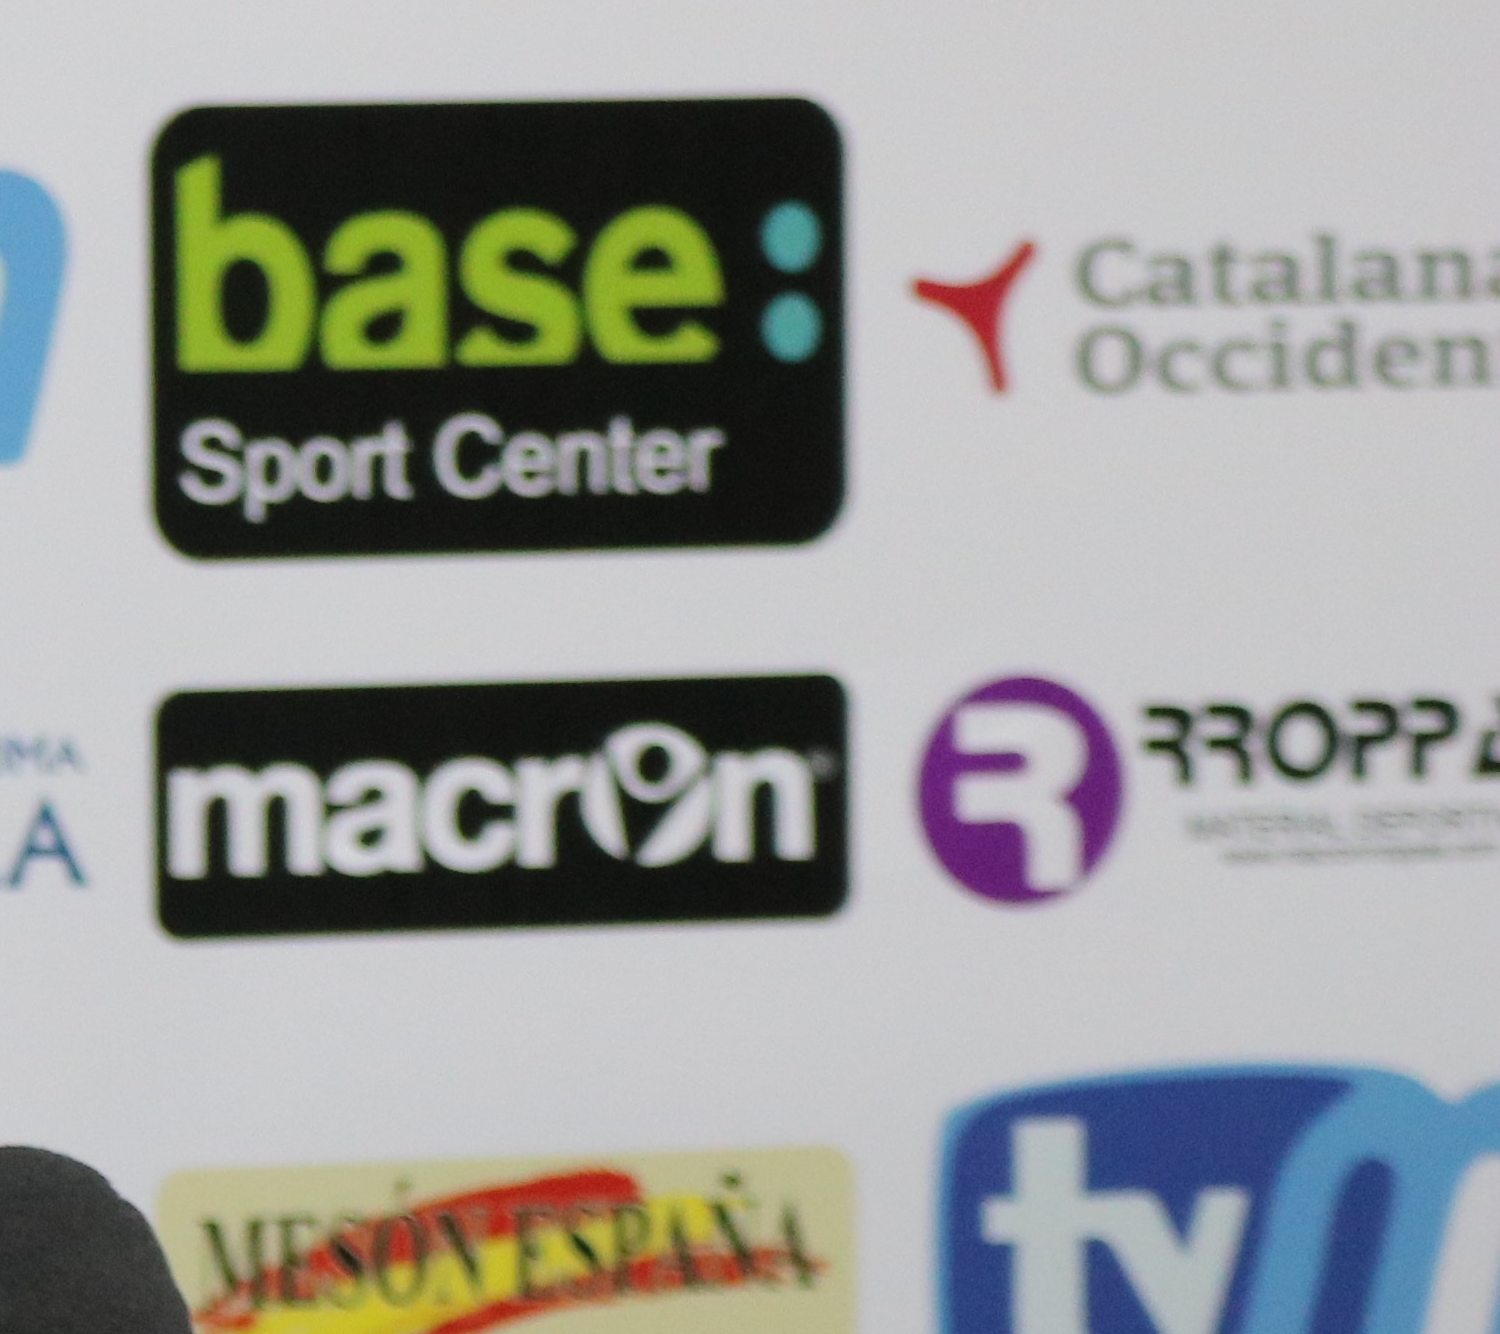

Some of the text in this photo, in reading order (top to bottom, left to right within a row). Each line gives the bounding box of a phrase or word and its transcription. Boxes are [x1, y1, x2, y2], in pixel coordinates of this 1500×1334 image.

[180, 413, 726, 523] Sport Center
[198, 1167, 822, 1313] MESÓN ESPAÑA
